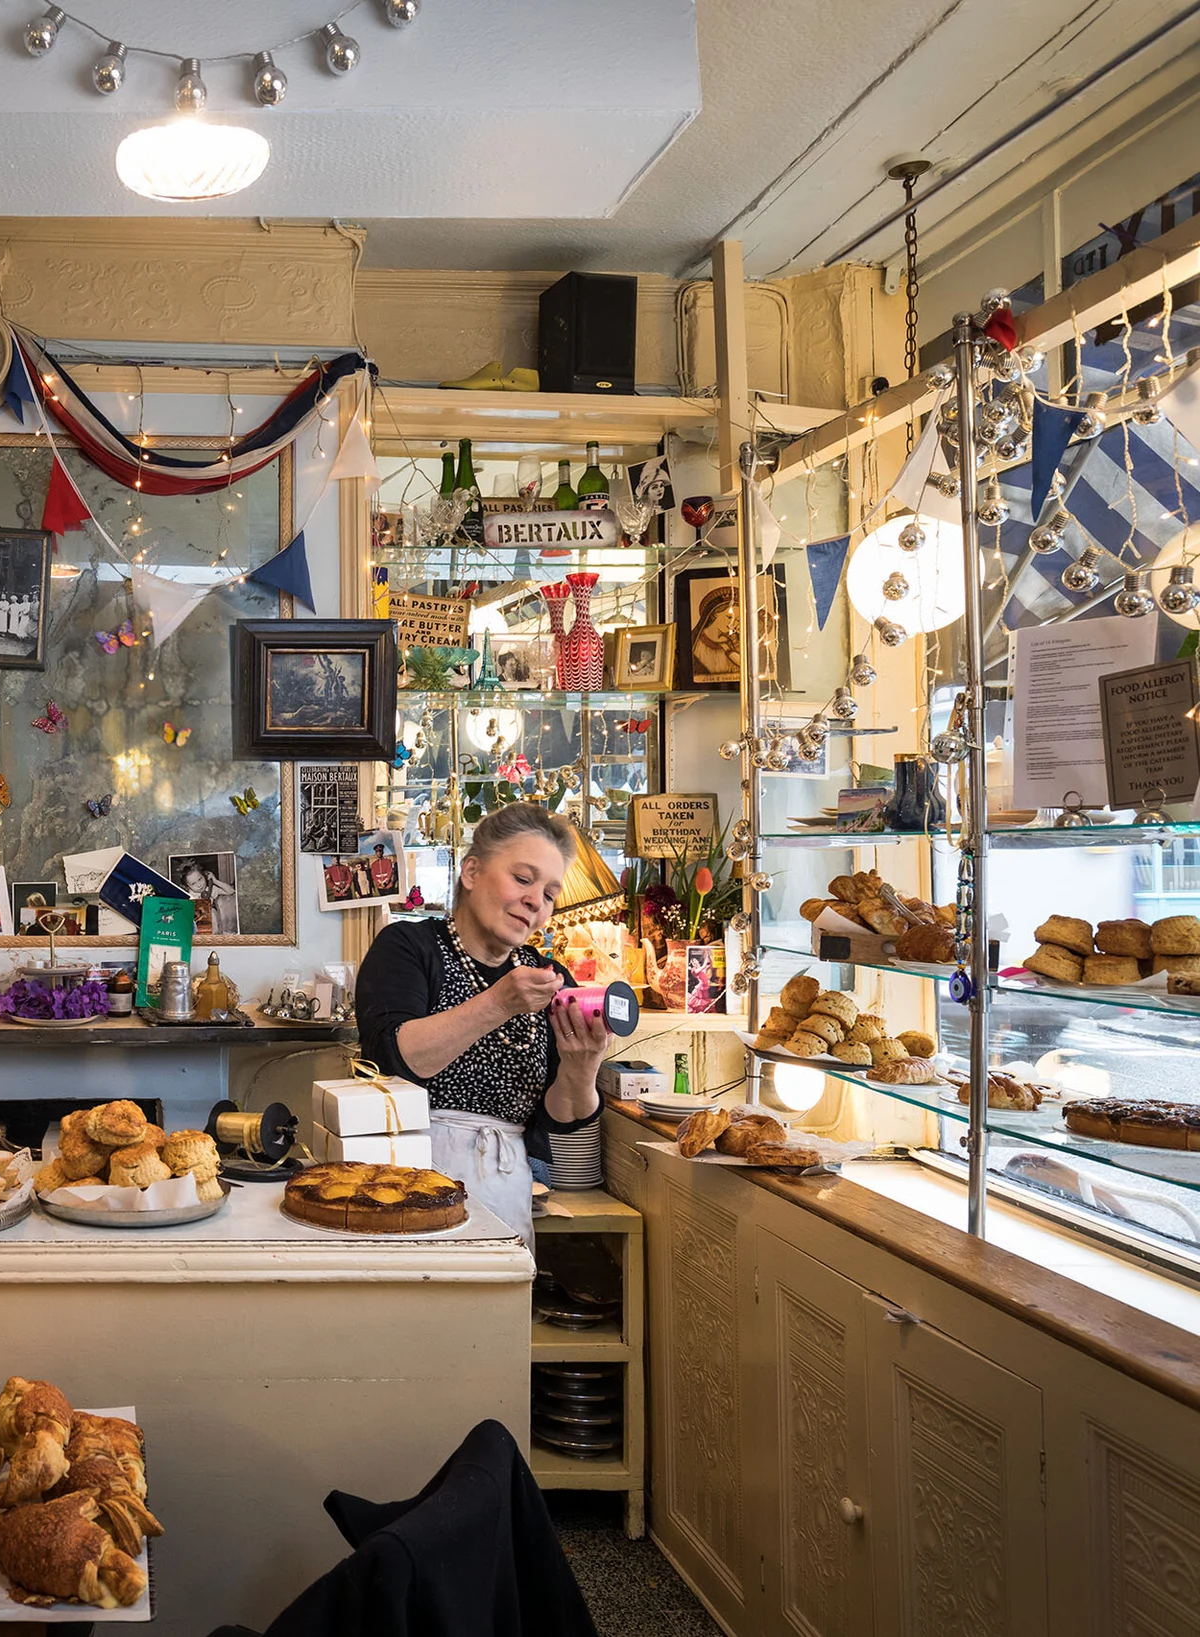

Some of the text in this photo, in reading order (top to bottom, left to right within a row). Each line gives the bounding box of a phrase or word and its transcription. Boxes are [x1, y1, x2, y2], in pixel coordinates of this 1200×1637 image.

[482, 503, 553, 513] ALL PASRIES
[497, 520, 604, 543] BERTAUX
[389, 598, 464, 614] ALL PASTRIES
[402, 619, 416, 629] RE
[399, 632, 418, 643] IRY
[420, 635, 460, 647] CREAM
[1111, 673, 1186, 696] FOOD ALLERGY
[1129, 688, 1168, 704] NOTICE
[1120, 729, 1140, 737] FOOD
[1142, 723, 1170, 733] ALLERGY
[1154, 730, 1184, 739] DIETARY
[1166, 737, 1189, 745] PLEASE
[1121, 753, 1149, 761] INFORM
[1150, 754, 1185, 764] CATERING
[1145, 766, 1164, 774] TEAM
[301, 771, 357, 781] MAISON BERTAUX
[1128, 776, 1184, 790] THANK YOU
[641, 801, 710, 810] ALL ORDERS
[658, 811, 694, 820] TAKEN
[668, 820, 684, 828] for
[652, 828, 701, 836] BIRTHDAY
